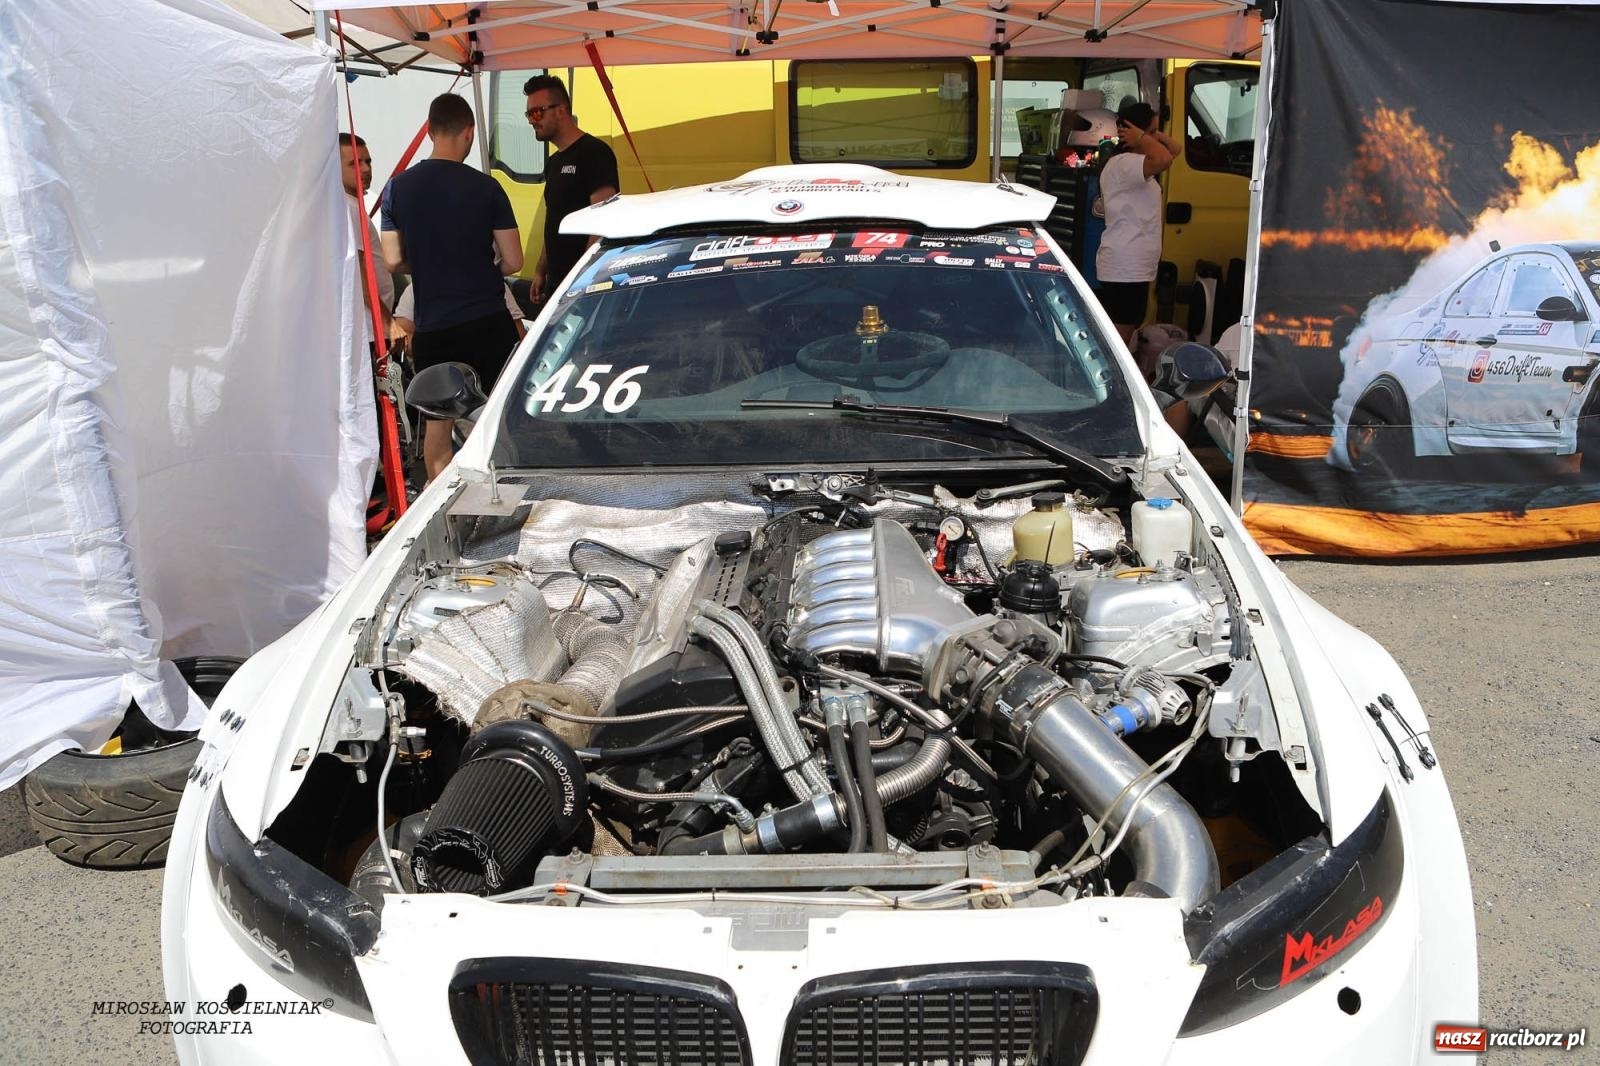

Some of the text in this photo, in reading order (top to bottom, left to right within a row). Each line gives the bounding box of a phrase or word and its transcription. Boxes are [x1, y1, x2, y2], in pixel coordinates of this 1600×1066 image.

[864, 232, 897, 244] 74
[530, 363, 650, 414] 456
[540, 745, 575, 816] TURBOSYSTEMS
